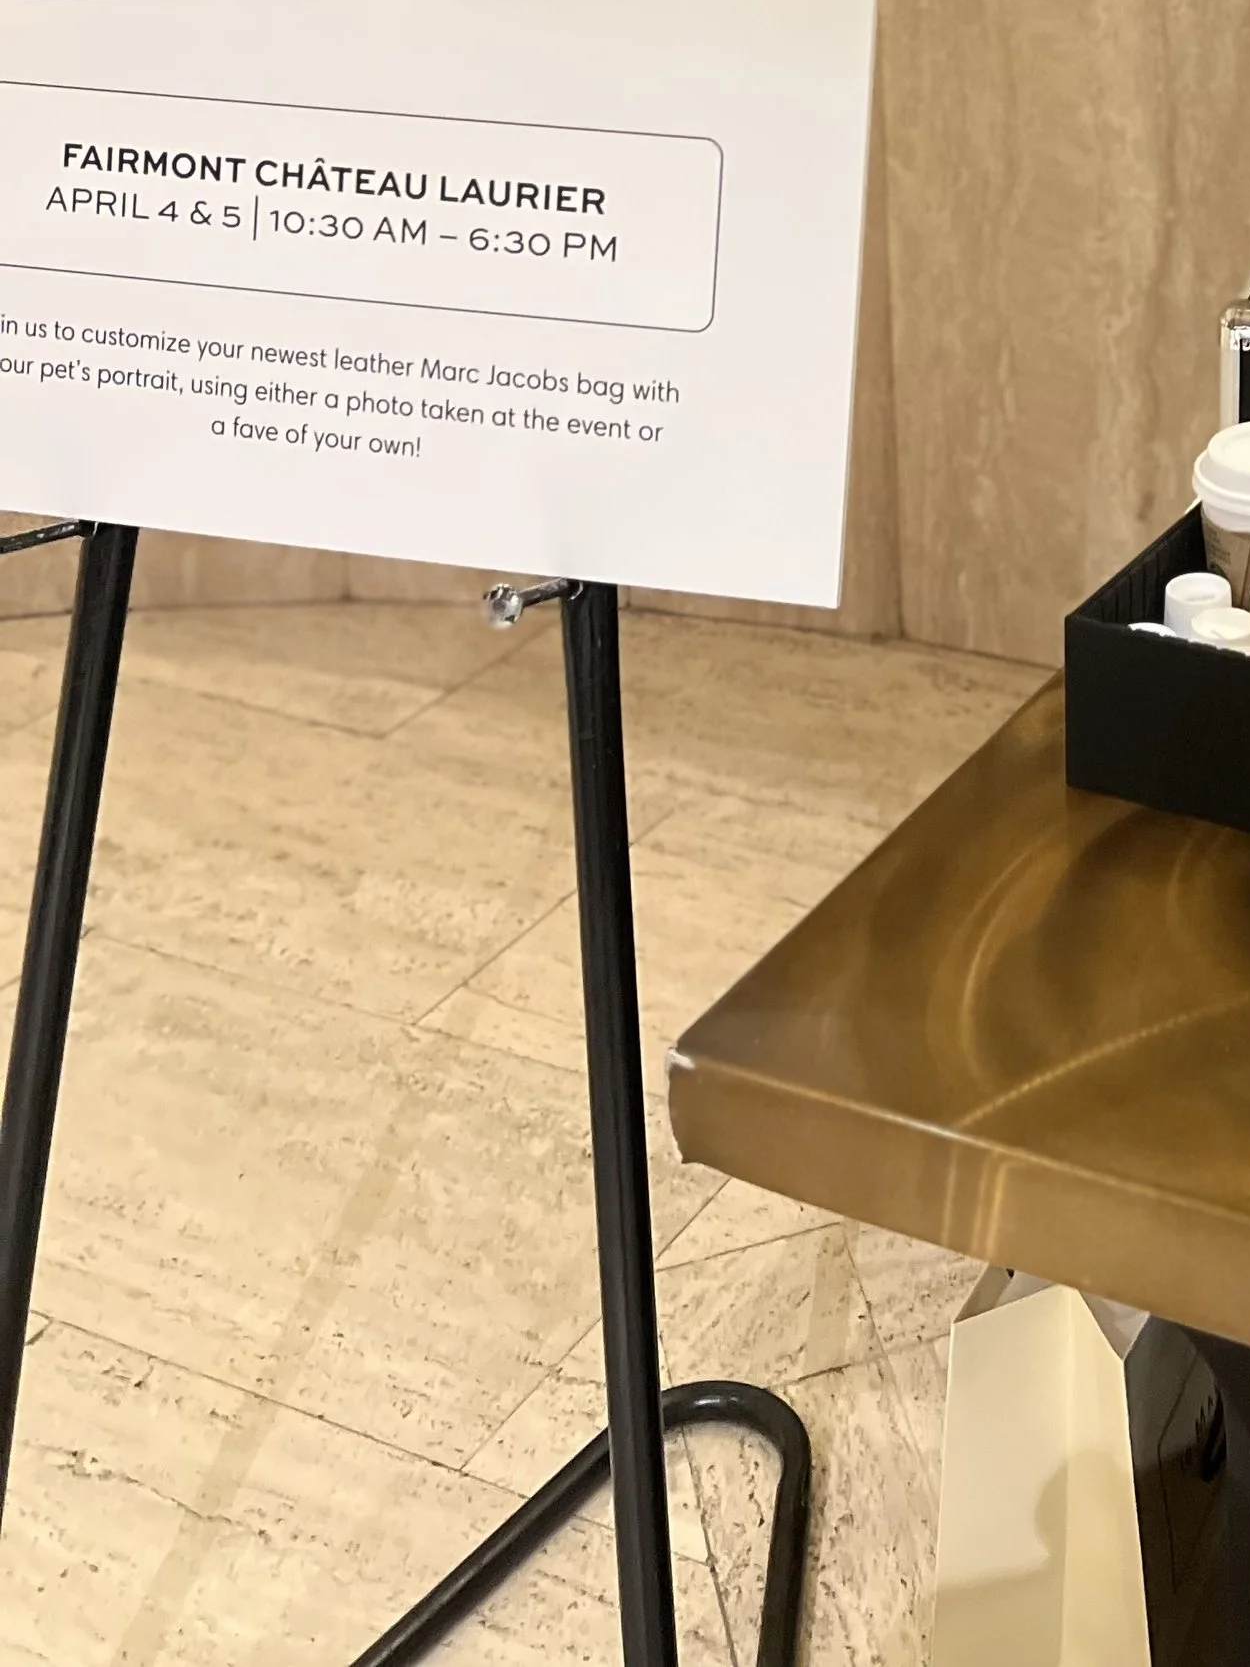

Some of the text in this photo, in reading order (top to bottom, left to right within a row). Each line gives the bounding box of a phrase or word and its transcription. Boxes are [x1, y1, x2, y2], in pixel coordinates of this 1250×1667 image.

[63, 142, 606, 216] FAIRMONT CHÂTEAU LAURIER
[45, 185, 150, 220] APRIL
[157, 200, 179, 223] 4
[189, 199, 213, 226] &
[221, 205, 241, 229] 5
[269, 209, 364, 240] 10:30
[372, 216, 427, 246] AM
[468, 227, 551, 257] 6:30
[562, 231, 618, 263] PM
[25, 321, 48, 339] us
[54, 320, 76, 342] to
[81, 327, 191, 354] customize
[197, 340, 245, 362] your
[250, 344, 328, 369] newest
[333, 347, 415, 377] leather
[420, 358, 480, 384] Marc
[486, 364, 569, 393] Jacobs
[577, 372, 625, 405] bag
[632, 379, 680, 404] with
[40, 359, 91, 383] pet's
[97, 367, 184, 396] portrait,
[190, 375, 248, 406] using
[254, 382, 318, 407] either
[324, 392, 338, 410] a
[346, 390, 414, 417] photo
[421, 398, 484, 425] taken
[491, 408, 516, 428] at
[523, 408, 560, 433] the
[566, 417, 631, 440] event
[638, 423, 664, 443] or
[211, 415, 422, 458] a fave of your own!
